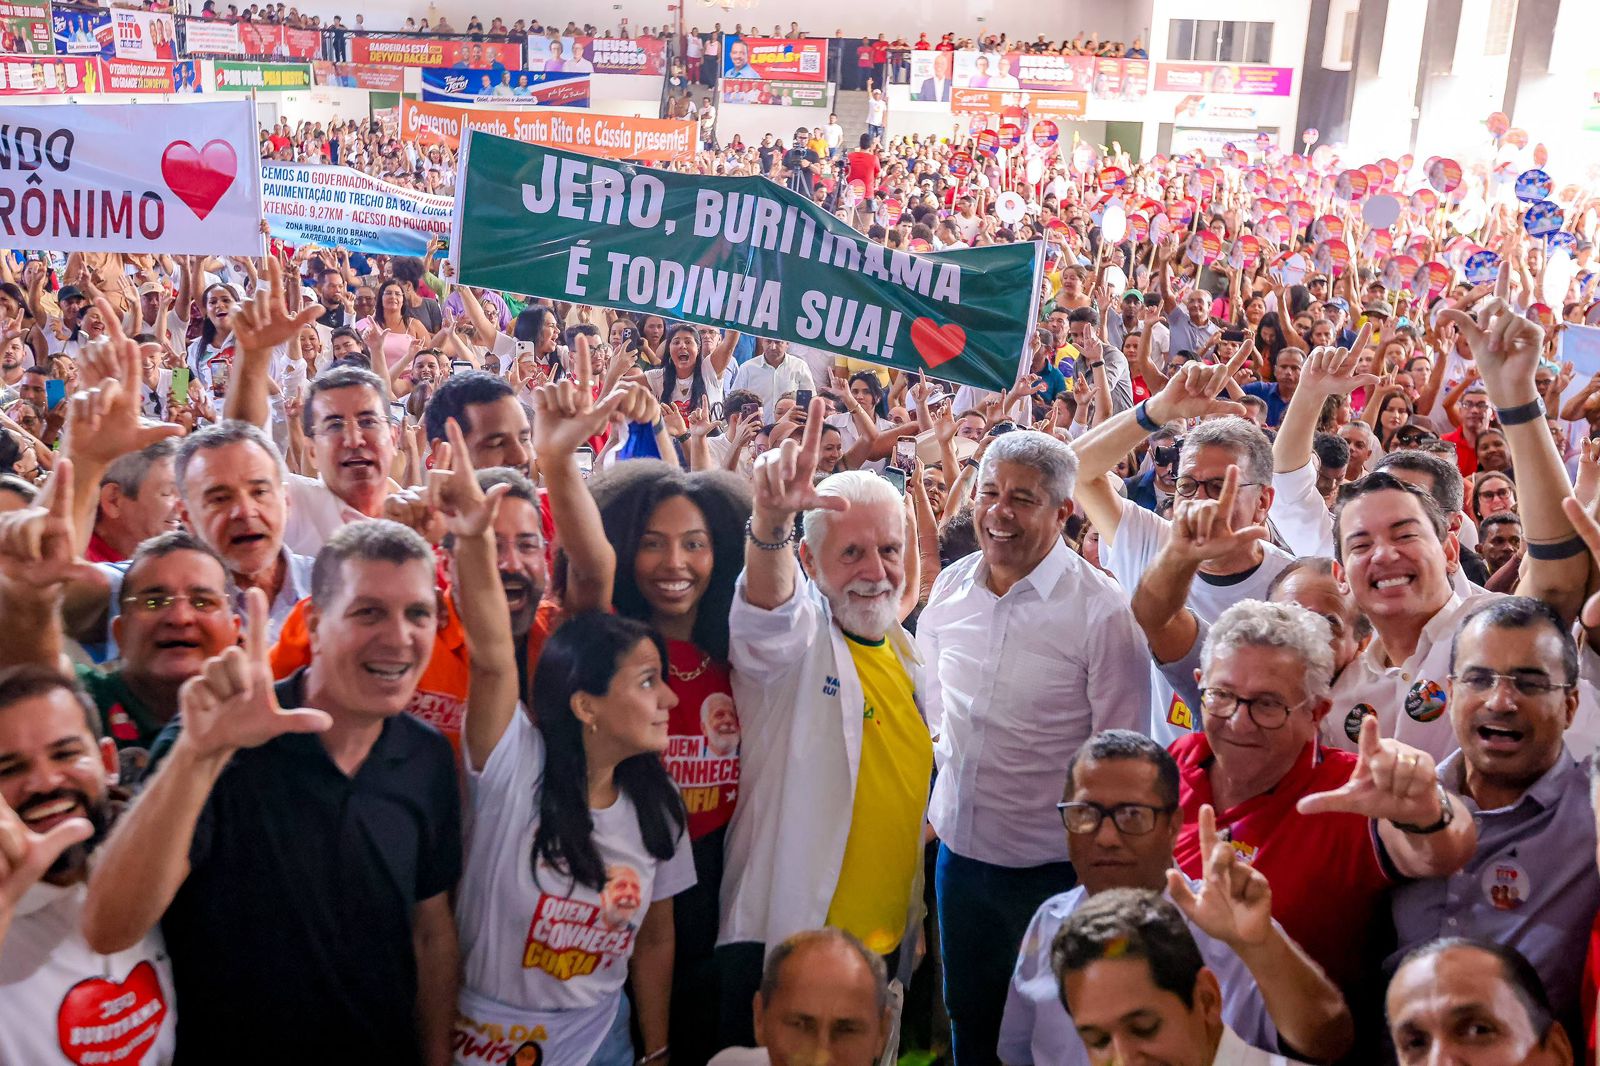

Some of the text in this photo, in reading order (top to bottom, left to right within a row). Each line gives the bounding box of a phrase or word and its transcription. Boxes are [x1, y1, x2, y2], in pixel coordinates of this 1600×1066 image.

[369, 43, 410, 52] BARREIRAS
[410, 43, 429, 53] ESTÁ
[369, 51, 443, 64] DEYVID BACELAR
[593, 51, 647, 65] AFONSO
[513, 117, 548, 141] Santa
[550, 117, 573, 143] Rita
[576, 118, 591, 145] de
[594, 119, 632, 149] Cássia
[634, 126, 690, 155] presente!
[261, 166, 295, 182] CEMOS
[296, 170, 310, 183] AO
[0, 172, 165, 241] RÔNIMO
[263, 183, 332, 203] PAVIMENTAÇÃO
[333, 190, 346, 204] NO
[349, 191, 384, 208] TRECHO
[385, 196, 398, 210] BA
[400, 198, 420, 214] 827,
[522, 153, 676, 236] JERO,
[263, 200, 308, 218] XTENSÃO:
[309, 205, 343, 221] 9,27KM
[351, 210, 387, 227] ACESSO
[389, 215, 401, 228] AO
[403, 217, 446, 234] POVOADO
[285, 221, 304, 231] ZONA
[304, 223, 325, 233] RURAL
[326, 226, 335, 234] DO
[336, 227, 349, 236] RIO
[300, 232, 336, 243] BARREIRAS
[565, 239, 902, 359] É TODINHA SUA!
[662, 737, 700, 758] UEM
[661, 758, 740, 785] ONHECE
[541, 897, 595, 922] QUEM
